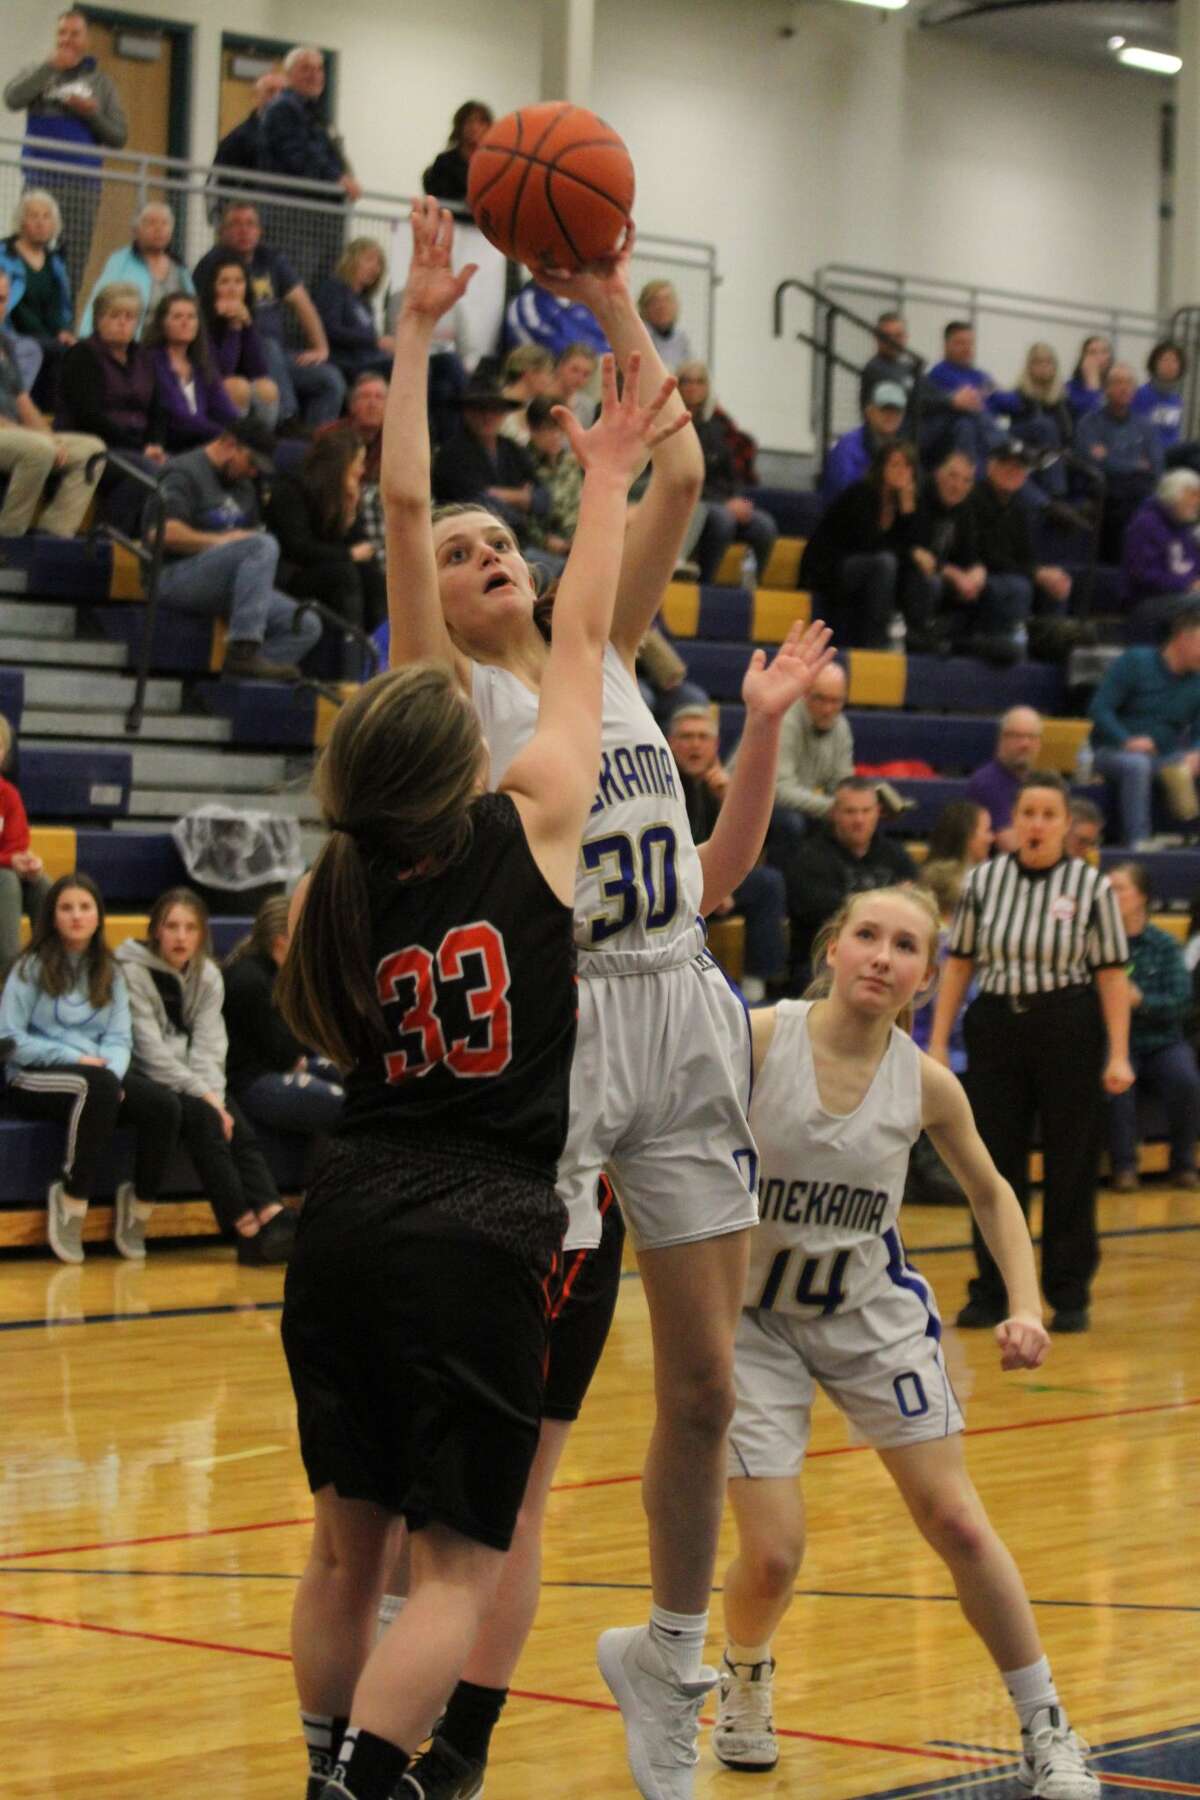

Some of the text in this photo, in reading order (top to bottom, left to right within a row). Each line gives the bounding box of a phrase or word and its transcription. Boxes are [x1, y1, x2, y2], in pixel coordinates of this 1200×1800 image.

[591, 744, 678, 813] KAMA
[581, 821, 679, 943] 30
[376, 920, 513, 1086] 33
[759, 1177, 888, 1234] NEKAMA
[759, 1249, 852, 1315] 14
